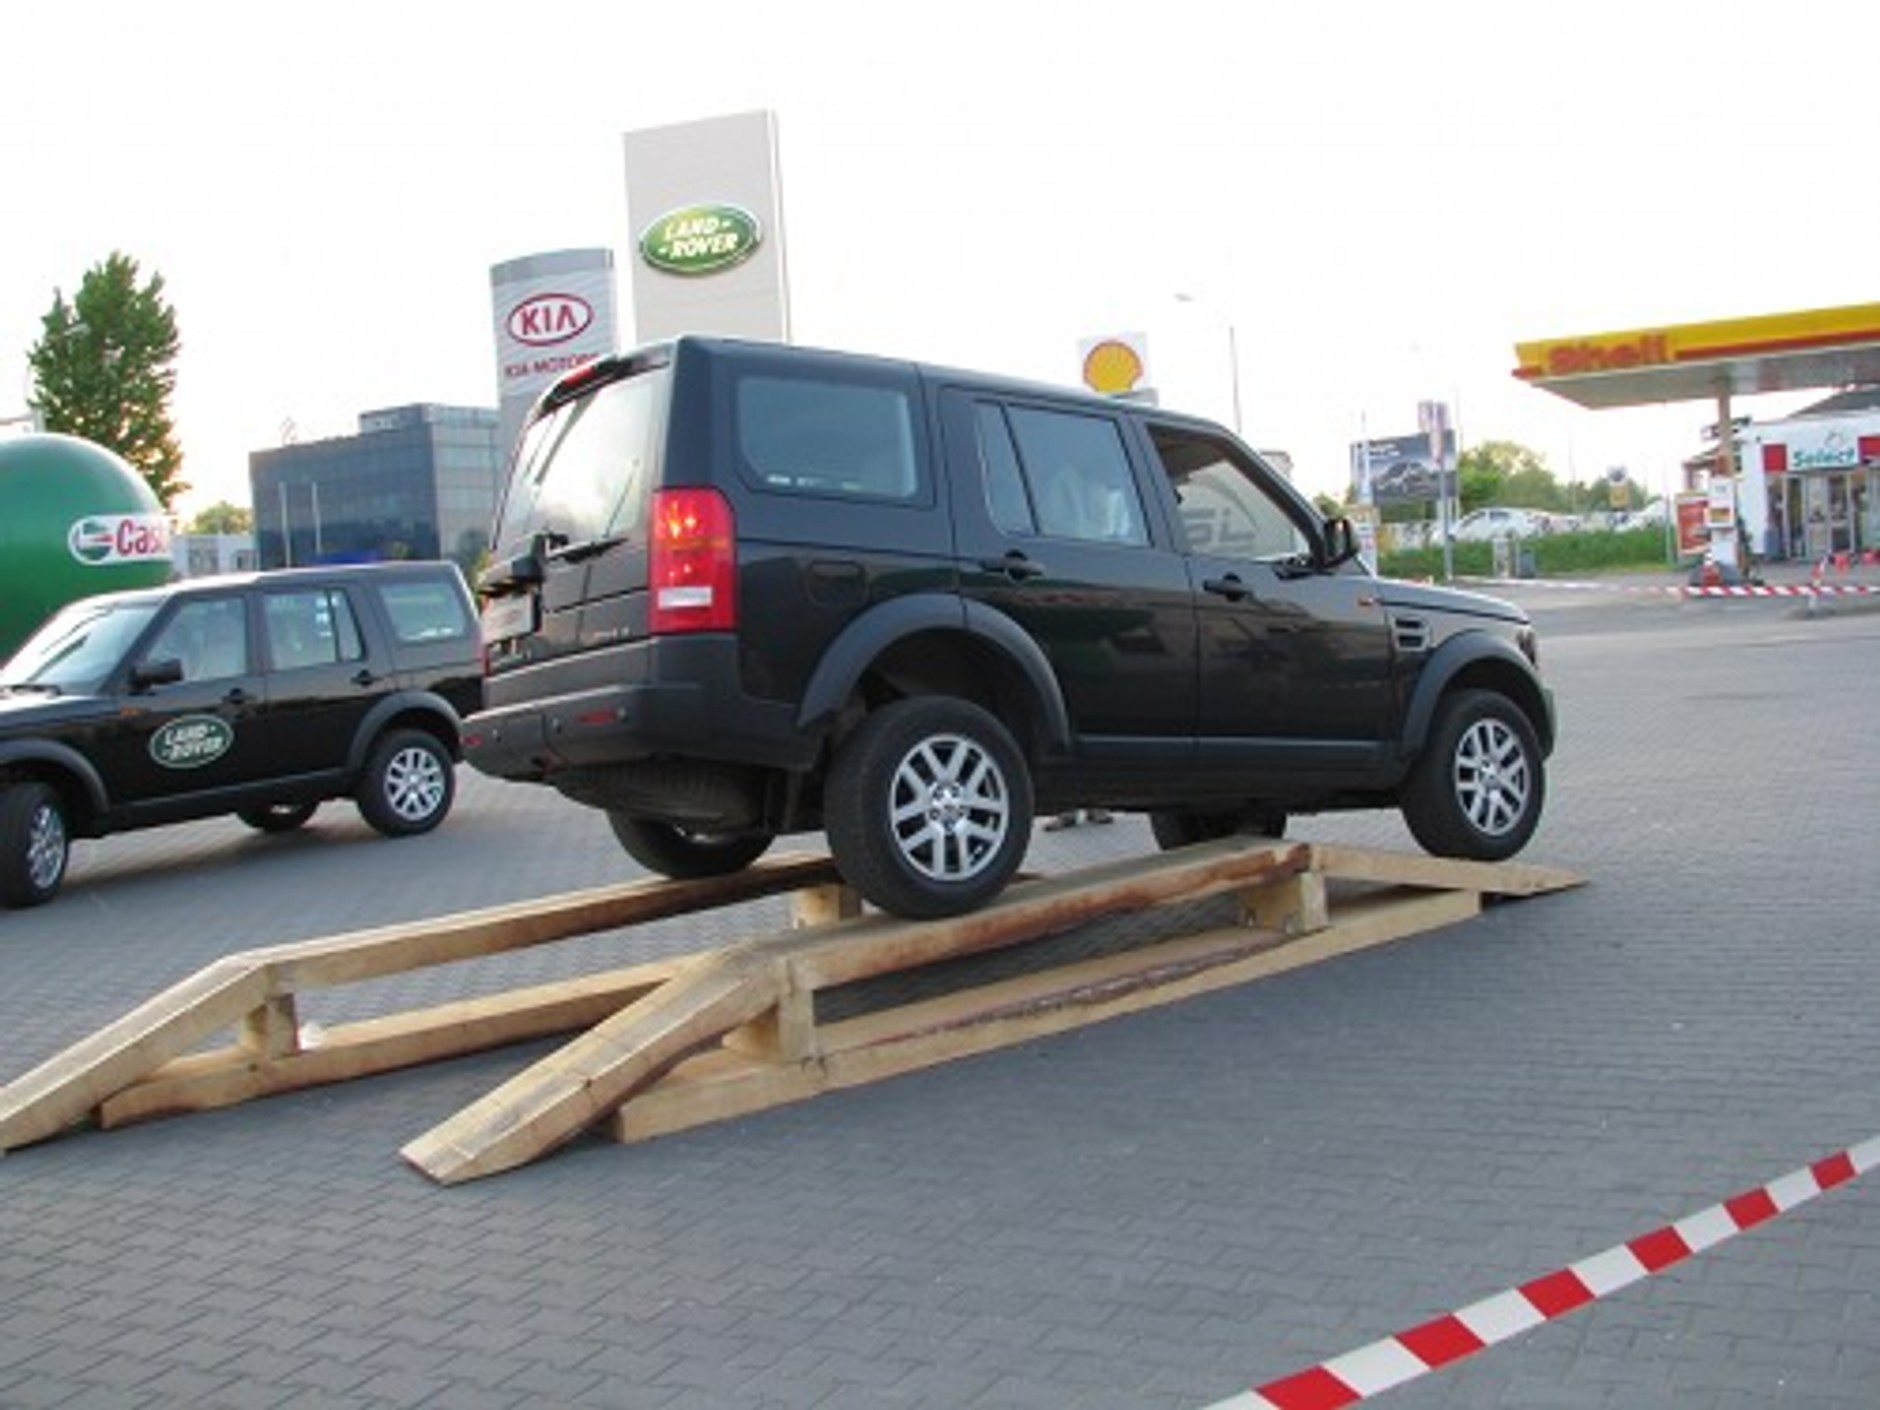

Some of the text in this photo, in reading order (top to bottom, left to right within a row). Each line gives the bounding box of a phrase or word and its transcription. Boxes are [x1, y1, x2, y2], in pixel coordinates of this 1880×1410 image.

[664, 216, 719, 240] LAND
[669, 233, 738, 259] ROVER
[521, 305, 577, 336] KIA
[505, 363, 529, 378] KIA
[165, 723, 208, 745] LAND
[169, 737, 222, 760] ROVER
